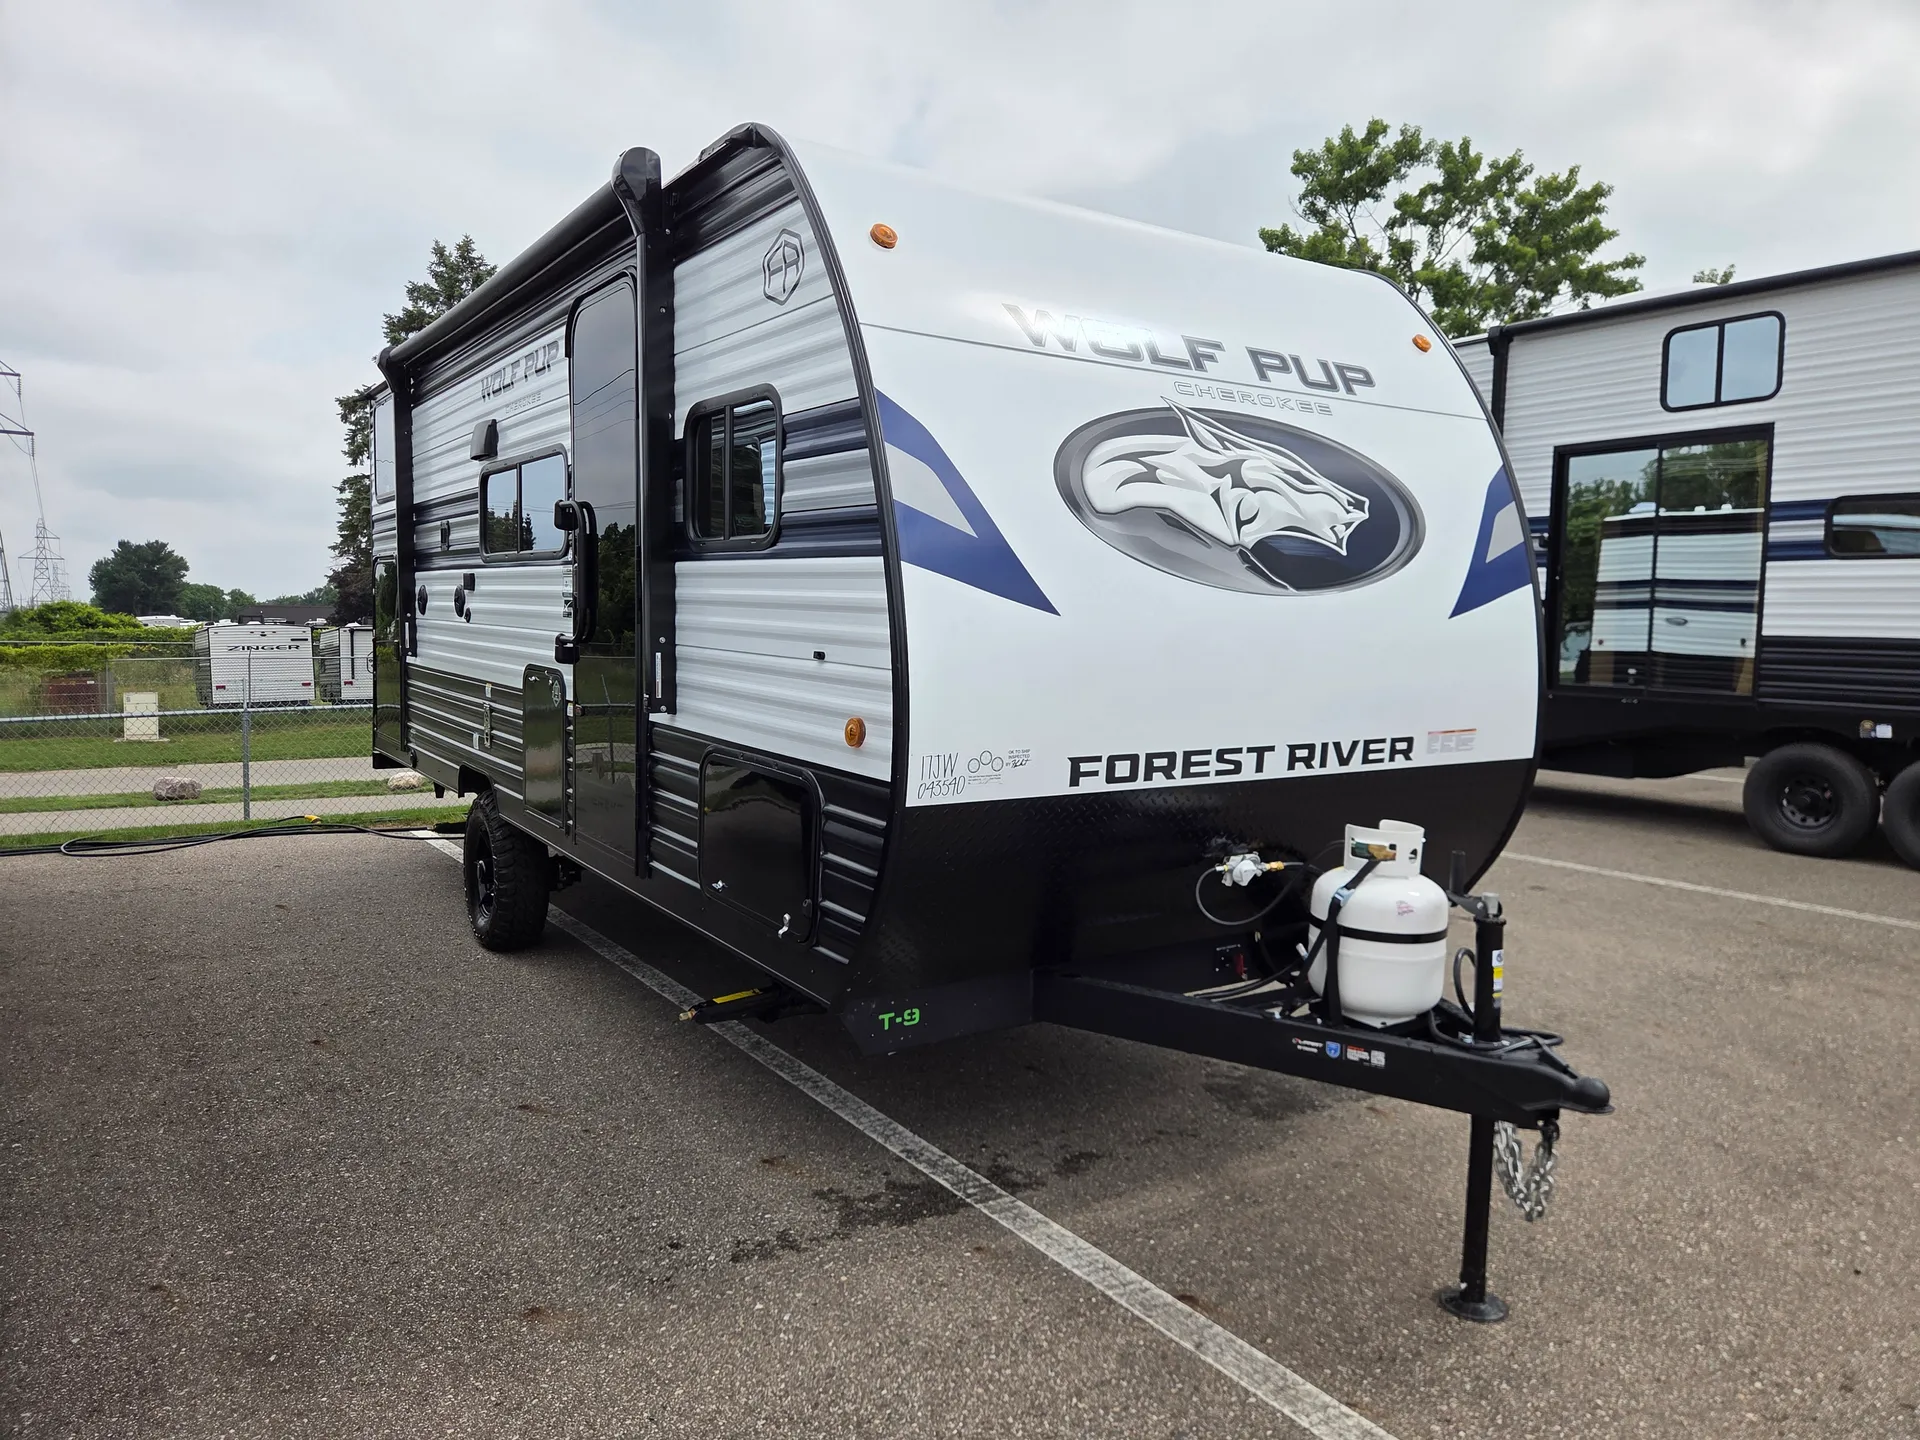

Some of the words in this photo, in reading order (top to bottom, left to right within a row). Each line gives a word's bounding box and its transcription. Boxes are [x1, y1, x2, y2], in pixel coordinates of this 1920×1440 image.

[481, 360, 521, 402] WOLF
[524, 340, 559, 382] PUP
[1002, 303, 1226, 373] WOLF
[1245, 346, 1376, 396] PUP
[1174, 381, 1333, 416] CHEROKEE
[918, 775, 966, 799] 043540
[1067, 745, 1276, 787] FOREST
[1286, 736, 1414, 771] RIVER
